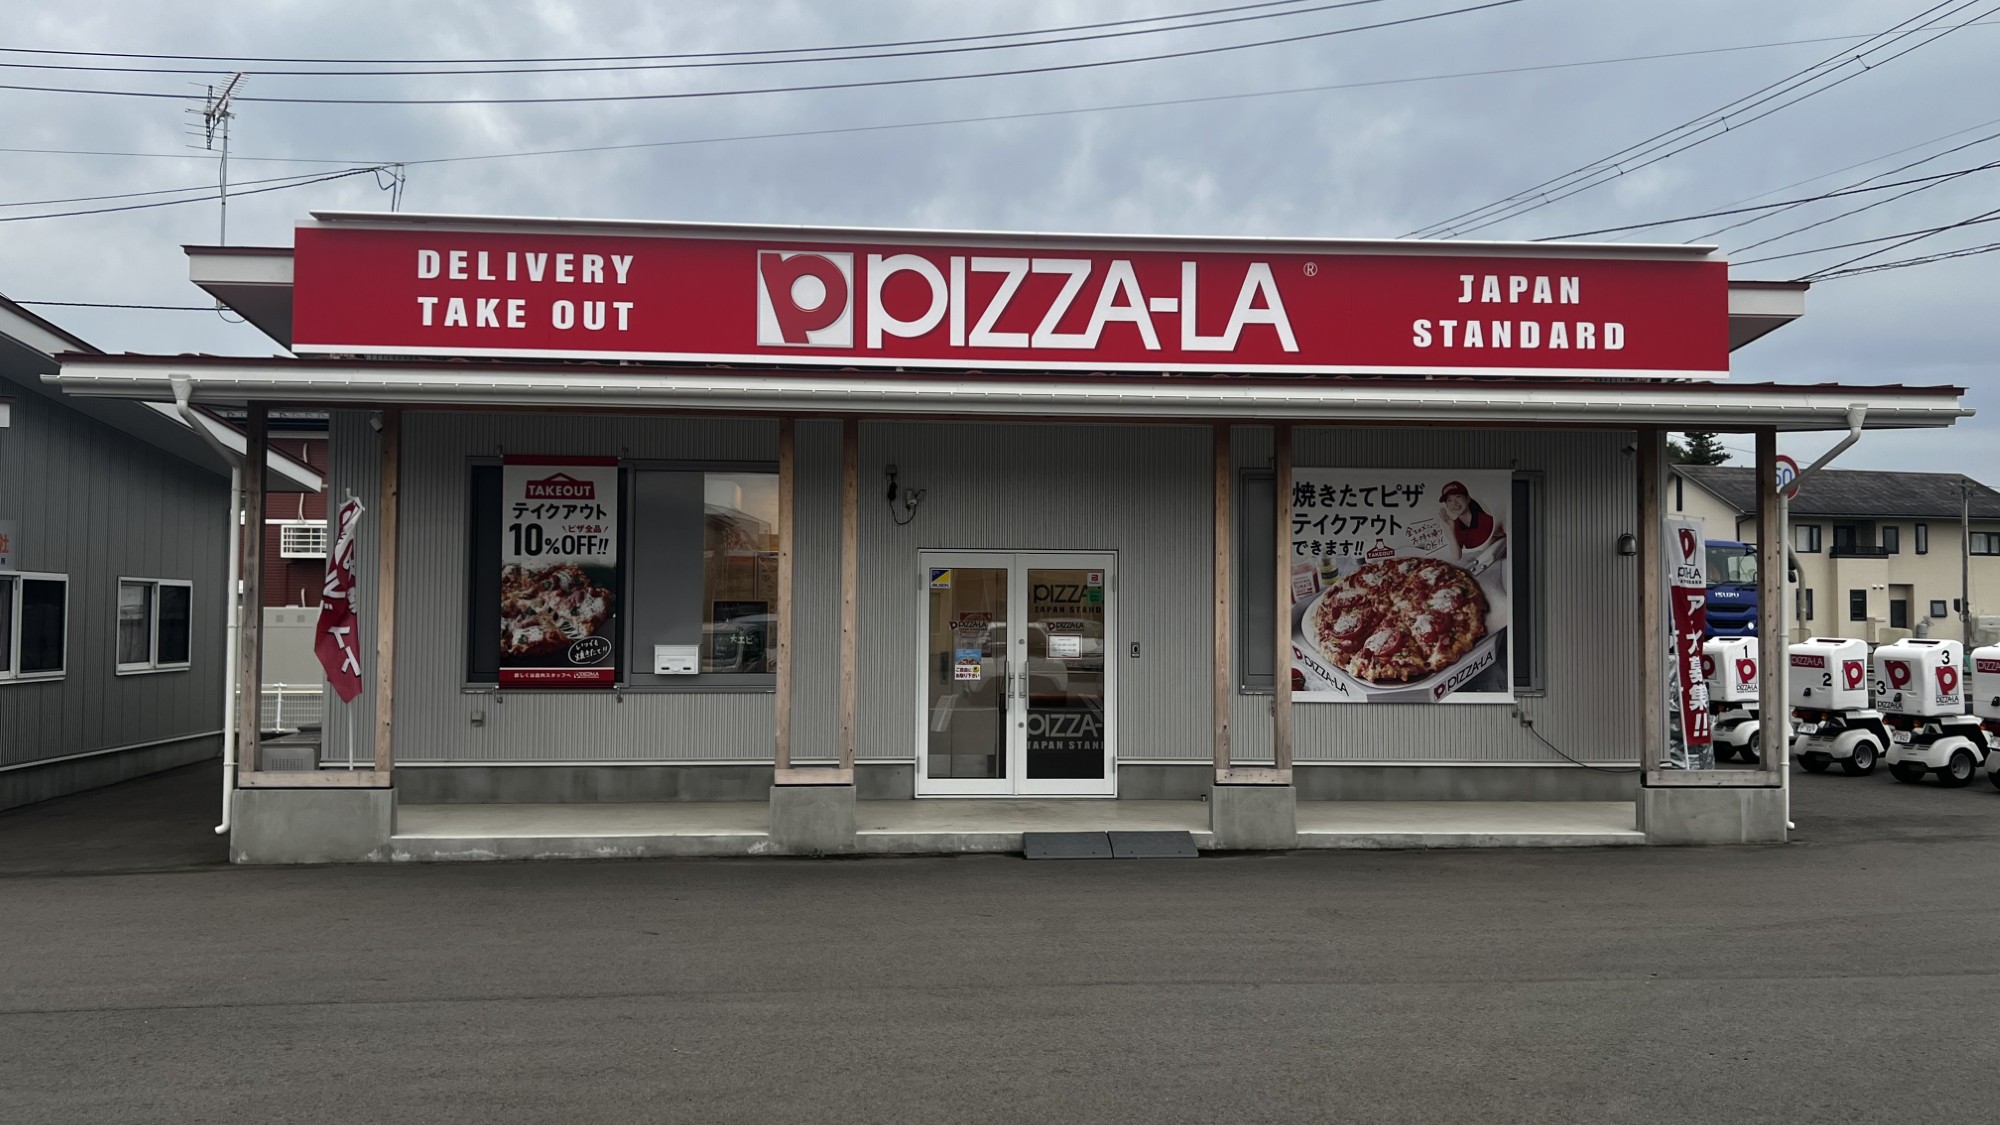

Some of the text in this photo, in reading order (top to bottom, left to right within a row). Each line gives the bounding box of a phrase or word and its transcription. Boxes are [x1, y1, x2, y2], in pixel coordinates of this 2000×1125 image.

[417, 249, 635, 284] DELIVERY
[1458, 274, 1580, 304] JAPAN
[867, 253, 1300, 352] PIZZA-LA
[417, 296, 635, 331] TAKE OUT
[1412, 319, 1625, 350] STANDARD
[528, 485, 592, 497] TAKEOUT
[1292, 481, 1426, 508] 焼きたてピザ
[512, 502, 607, 521] テイクアウト
[567, 524, 602, 534] ピザ全品
[1292, 513, 1403, 536] テイクアウト
[509, 522, 609, 556] 10%OFF!!
[1292, 540, 1364, 556] できます!!
[1368, 550, 1394, 558] TAKEOUT
[1743, 645, 1748, 658] 1
[1942, 650, 1950, 664] 3
[1792, 656, 1824, 666] PIZZA-LA
[1447, 651, 1493, 691] PIZZA-LA
[1822, 672, 1832, 686] 2
[1876, 680, 1886, 695] 3
[1069, 741, 1103, 750] STAN
